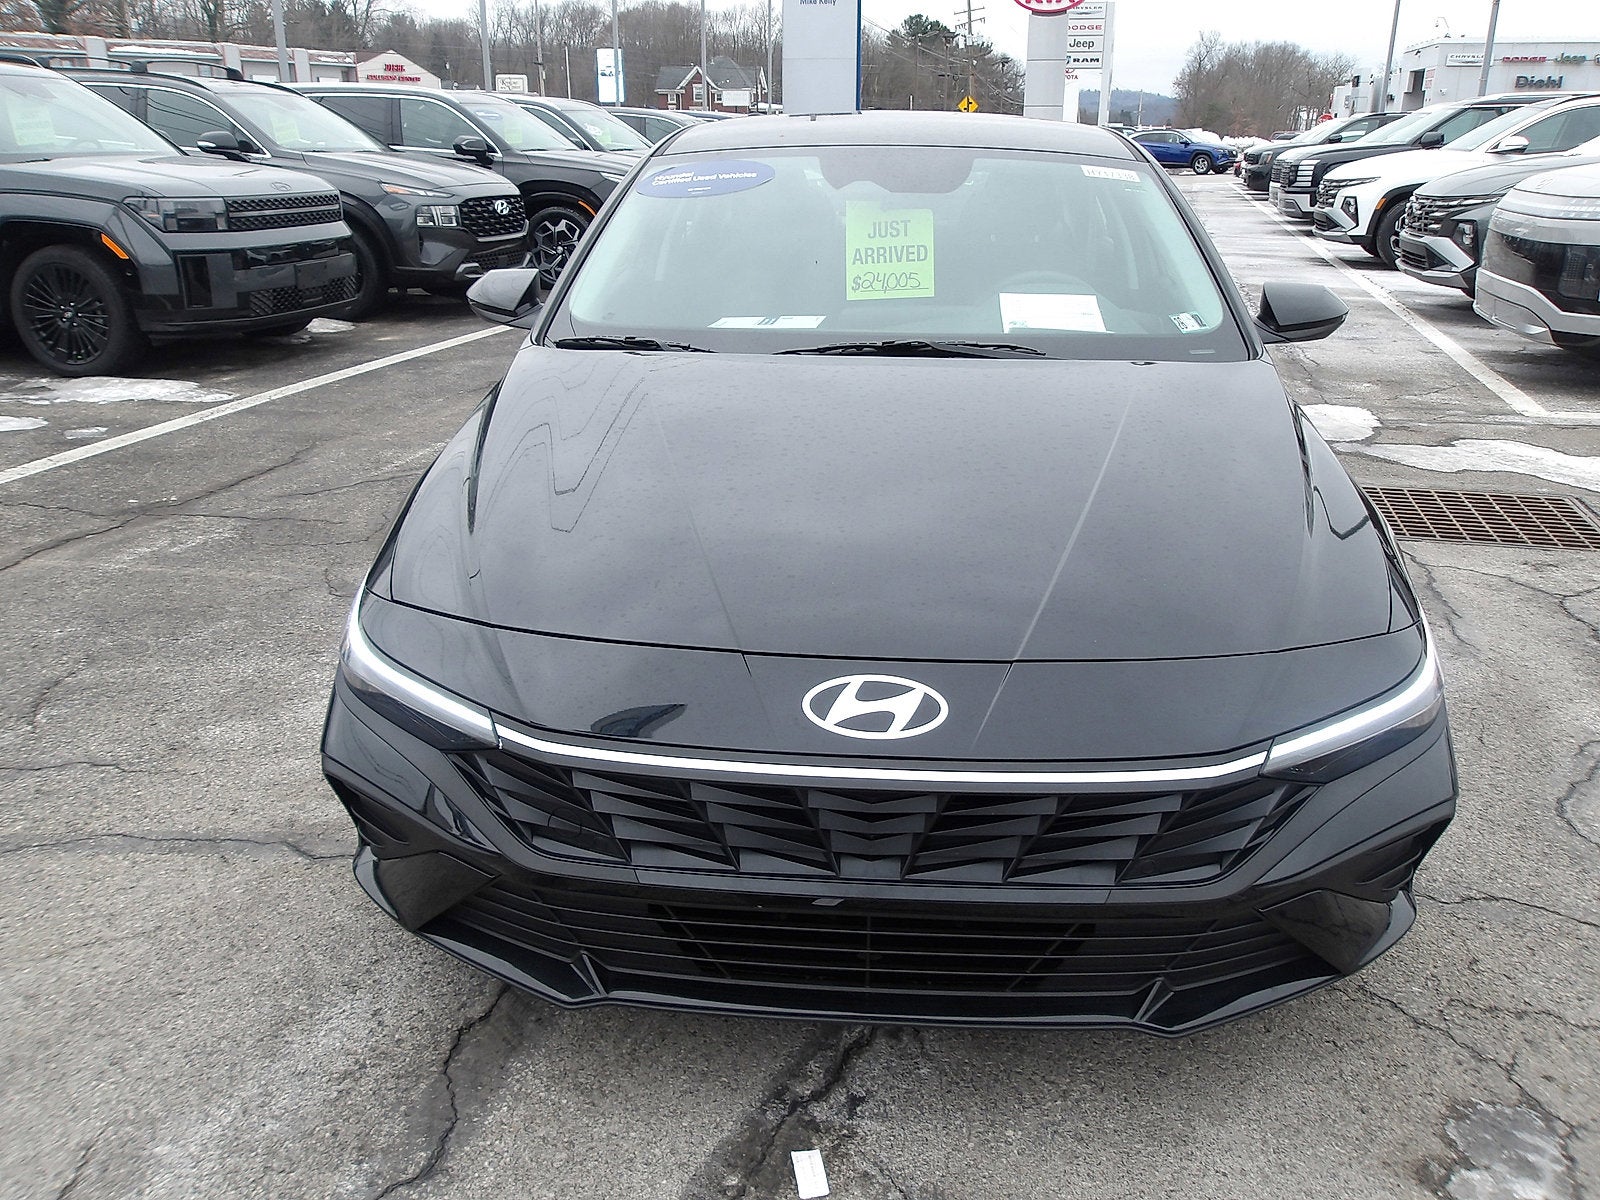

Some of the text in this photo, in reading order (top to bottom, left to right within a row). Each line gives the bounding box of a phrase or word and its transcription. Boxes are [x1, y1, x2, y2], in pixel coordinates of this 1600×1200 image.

[1069, 39, 1094, 49] Jeep
[1555, 52, 1587, 64] Jeep
[1515, 75, 1564, 88] Diehl
[867, 219, 912, 239] JUST
[851, 244, 929, 265] ARRIVED
